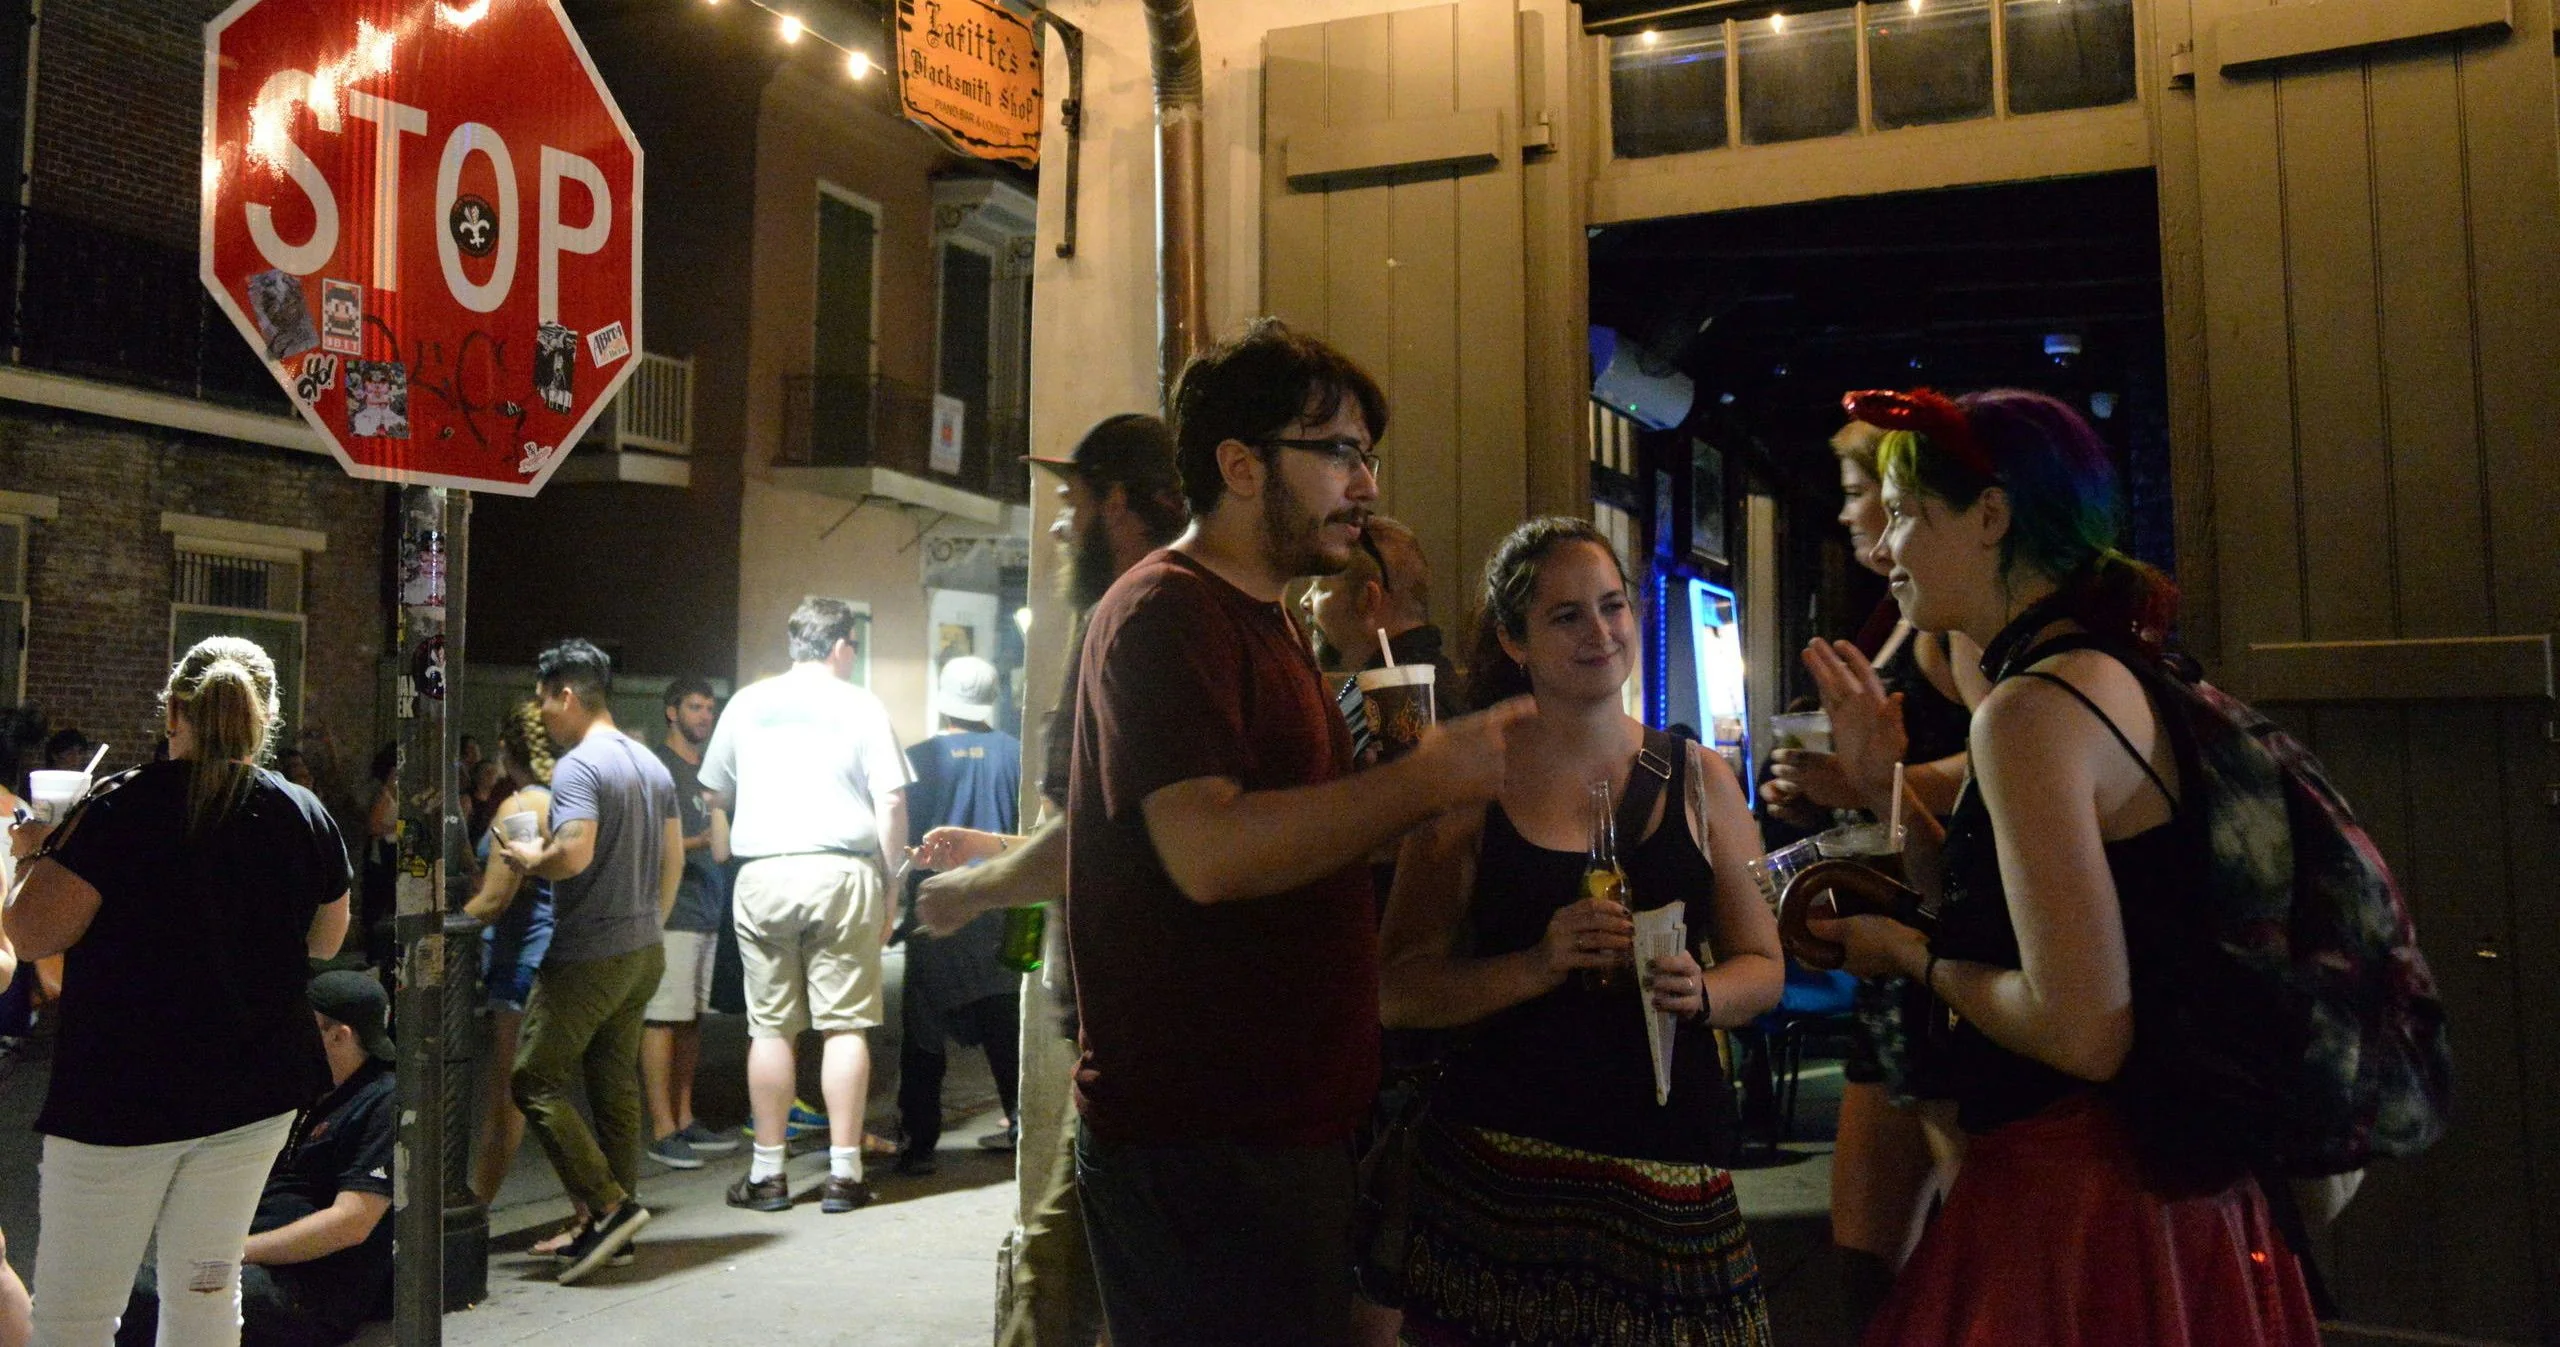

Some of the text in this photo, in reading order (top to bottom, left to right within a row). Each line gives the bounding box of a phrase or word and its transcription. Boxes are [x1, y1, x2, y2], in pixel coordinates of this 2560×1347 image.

[911, 49, 1033, 122] Blacksmith Shop
[245, 68, 612, 325] STOP
